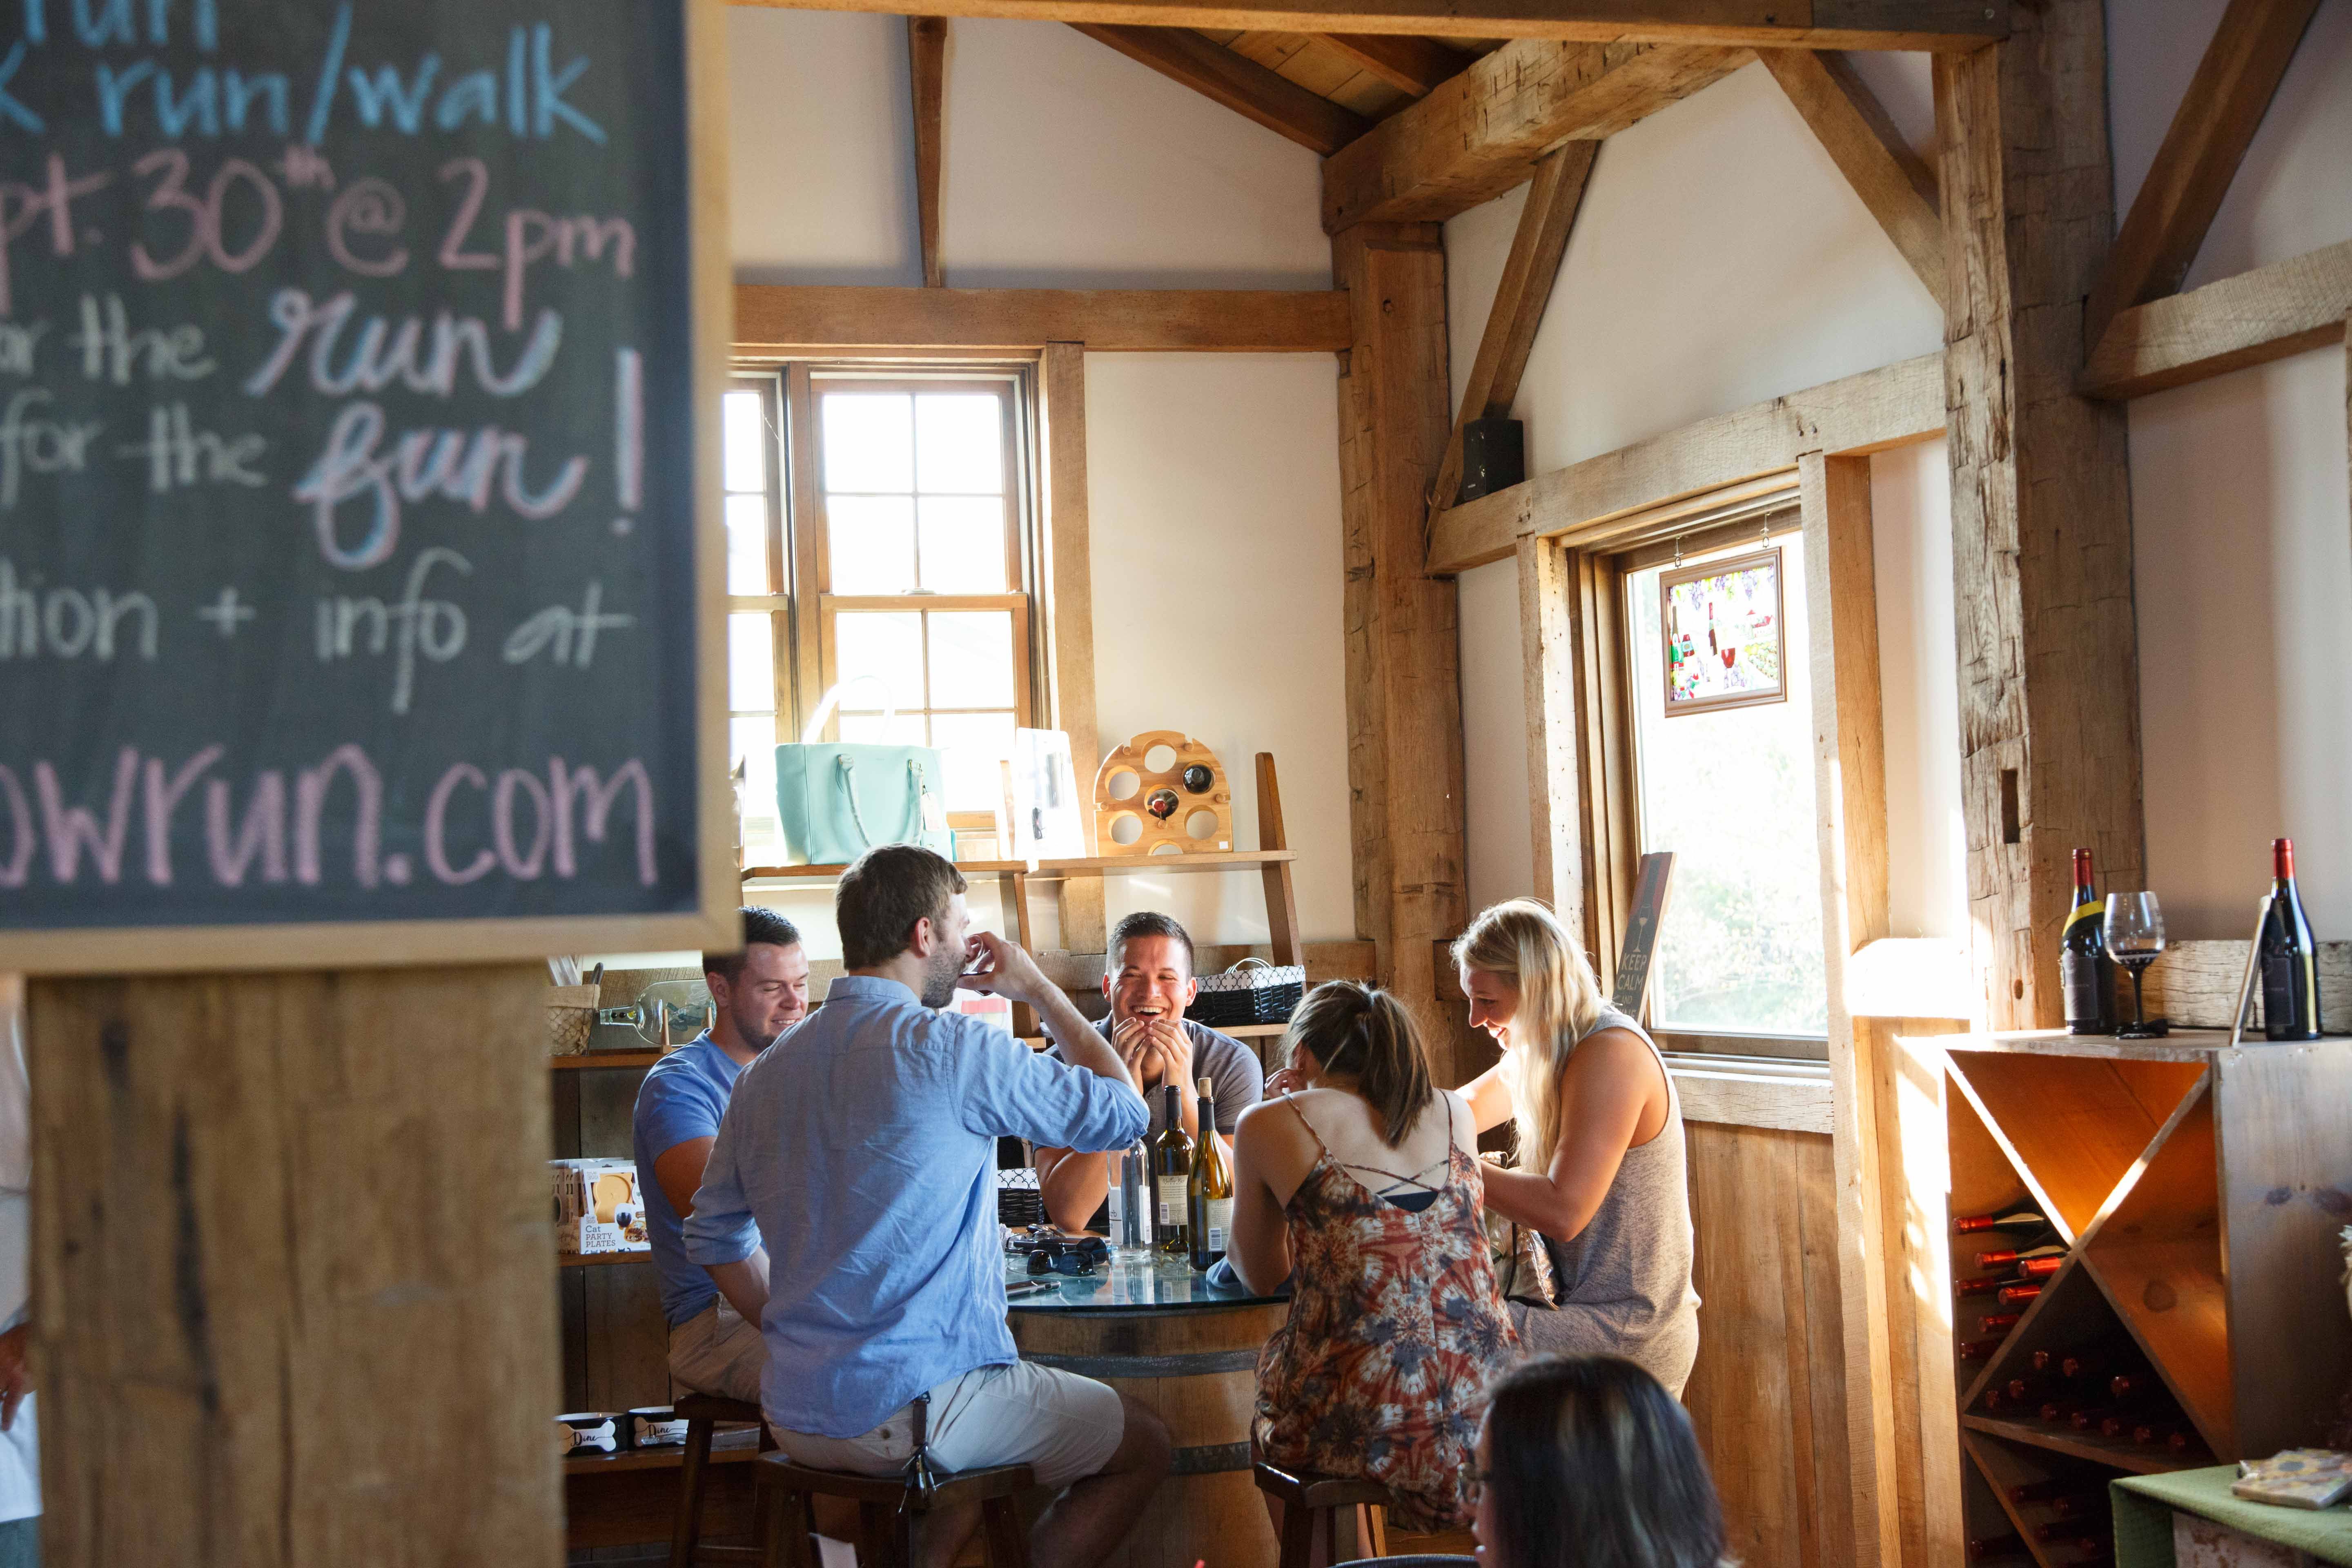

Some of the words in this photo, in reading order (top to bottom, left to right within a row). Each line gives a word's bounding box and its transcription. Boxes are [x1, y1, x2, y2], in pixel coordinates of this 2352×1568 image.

[94, 20, 608, 145] run/walk
[328, 176, 408, 278] @
[438, 158, 638, 332] 2pm
[61, 291, 216, 387] the
[243, 287, 564, 398] run
[116, 402, 272, 494] the
[199, 585, 256, 638] +
[314, 546, 474, 717] info
[501, 581, 638, 670] at
[1617, 973, 1644, 991] CALM
[1621, 953, 1647, 971] KEEP
[566, 1431, 599, 1447] Dine
